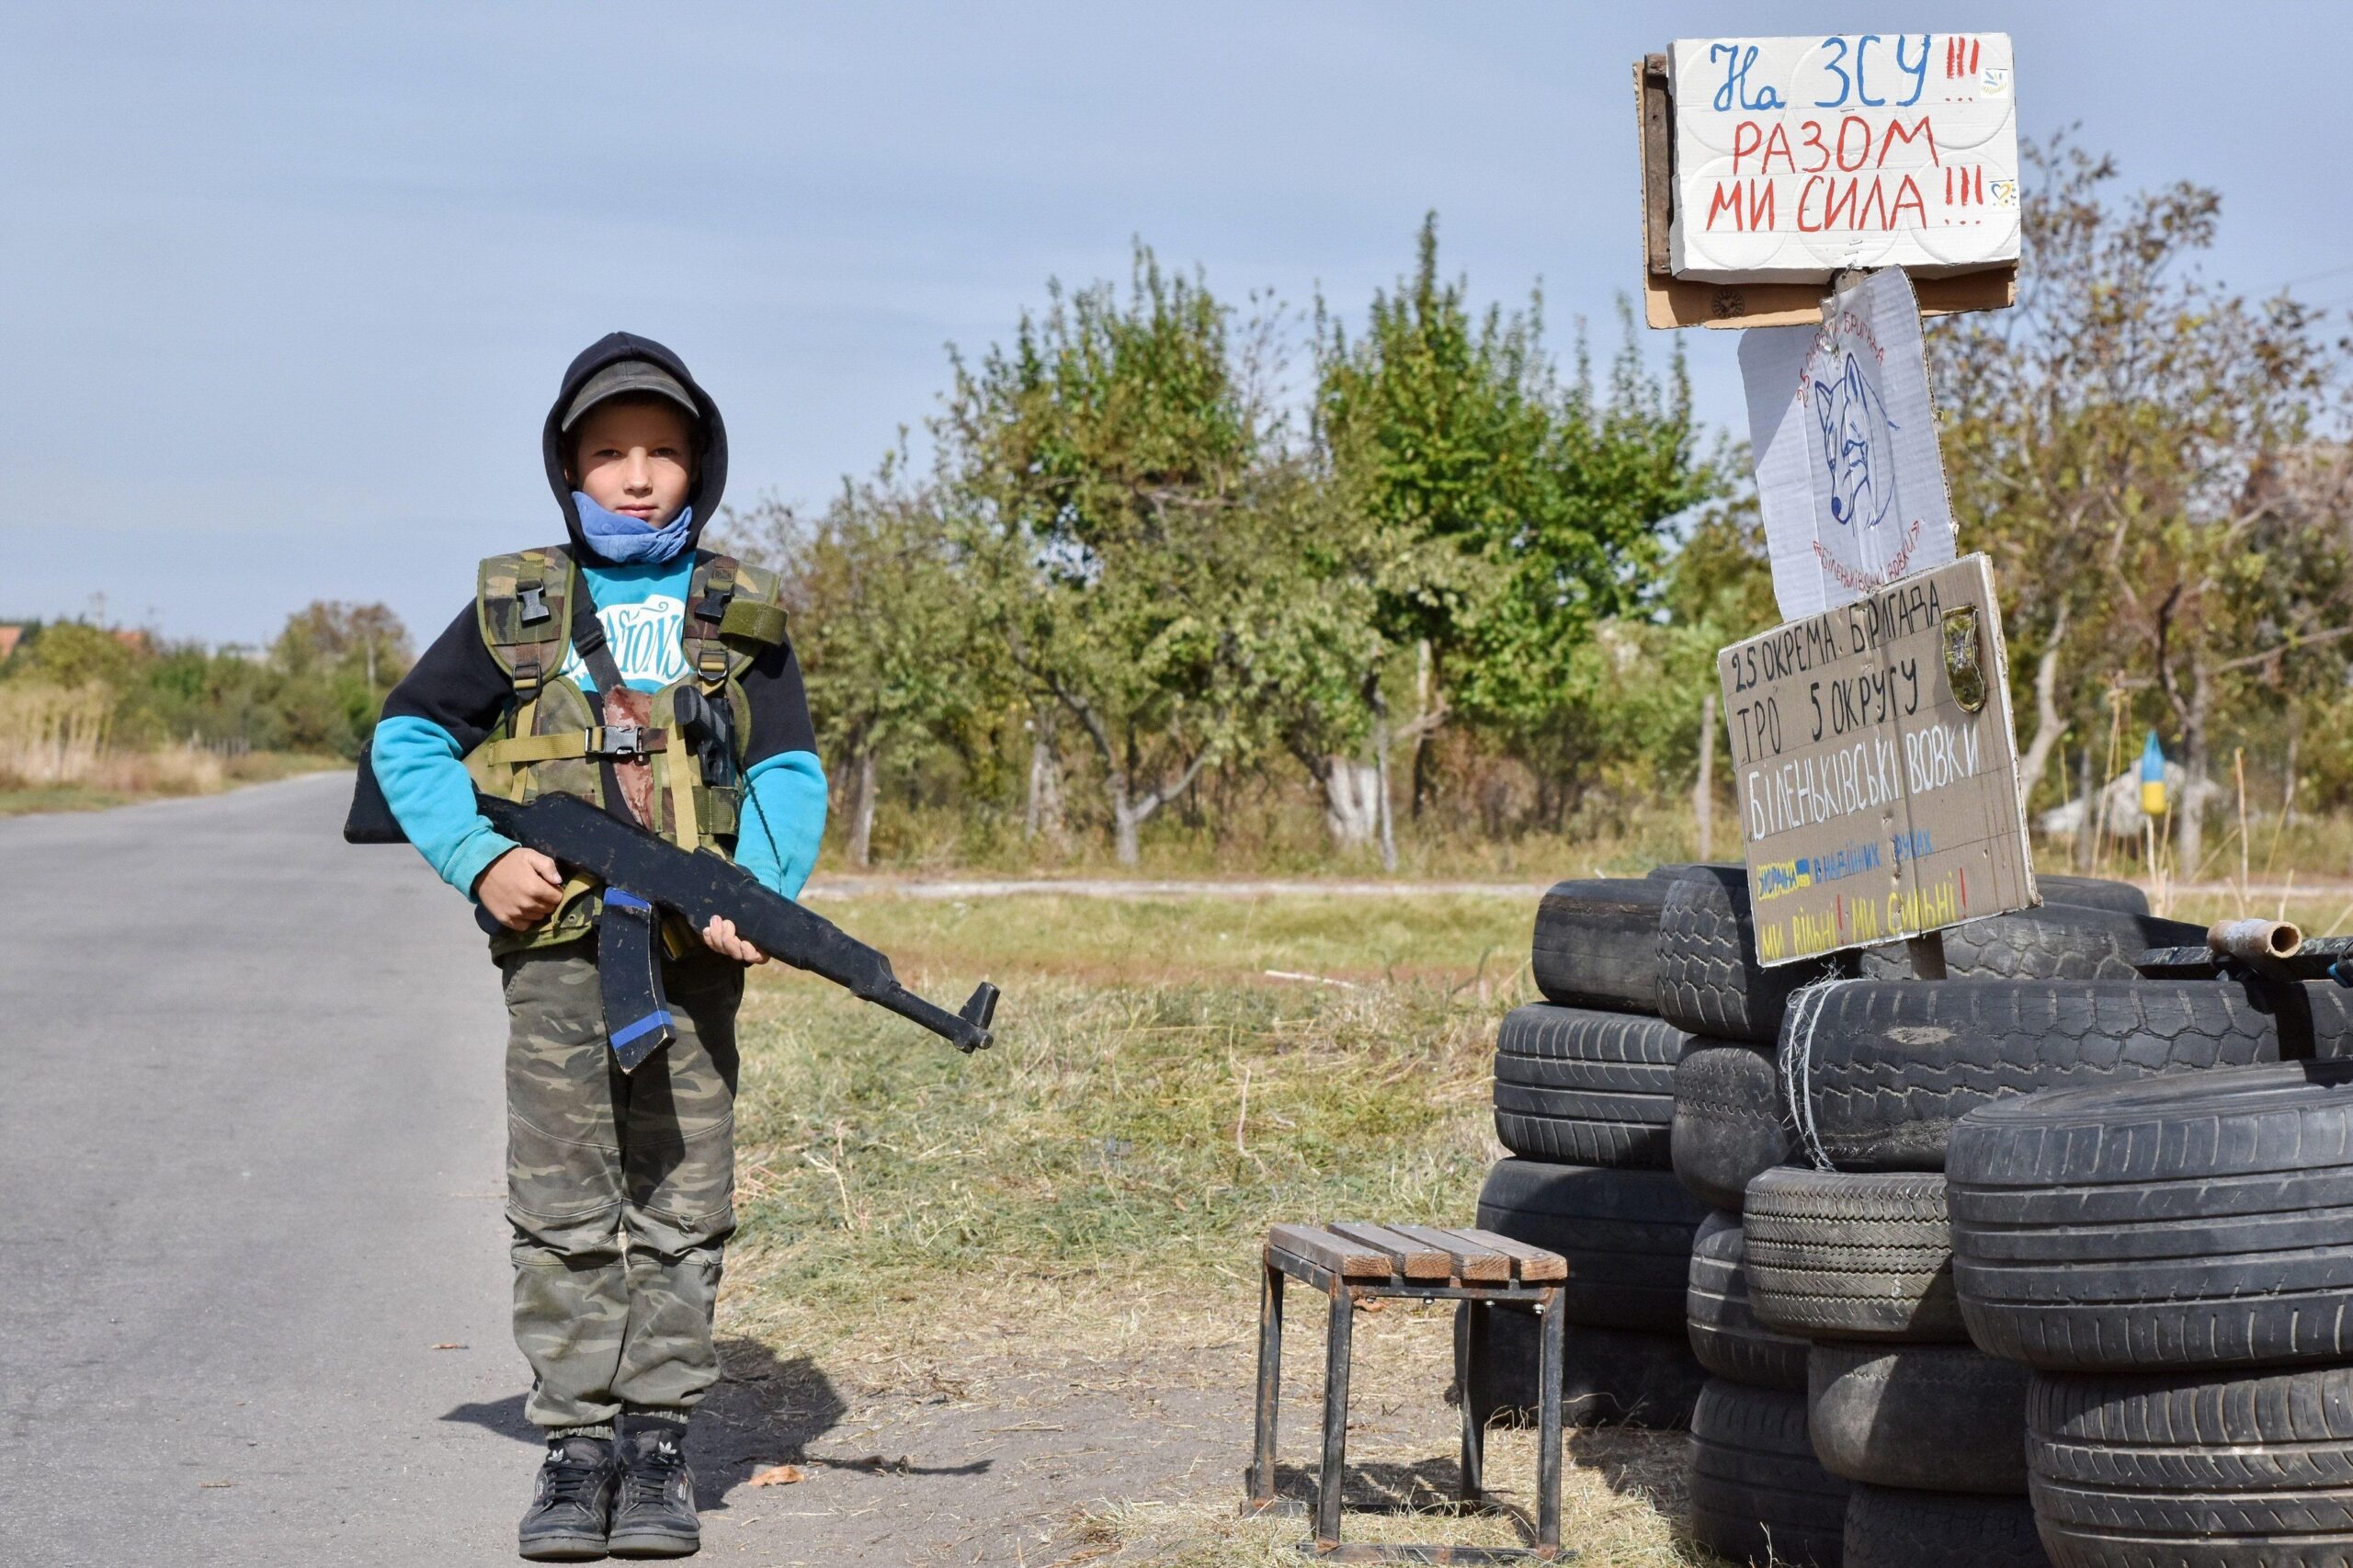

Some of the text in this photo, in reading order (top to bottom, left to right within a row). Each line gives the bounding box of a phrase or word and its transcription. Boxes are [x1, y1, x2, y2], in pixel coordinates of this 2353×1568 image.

[1711, 44, 1786, 111] На
[1733, 116, 1938, 175] РАЗОМ
[1706, 178, 1775, 231] МИ
[1732, 581, 1942, 693] 25 ОКРЕМА БРИГАДА
[1736, 657, 1918, 763] ТРО 5 ОКРУГУ
[1748, 722, 1980, 842] БІЛЕНЬКІВСЬКІ ВОВКИ
[1761, 922, 1785, 962] МИ
[1851, 895, 1878, 943] МИ
